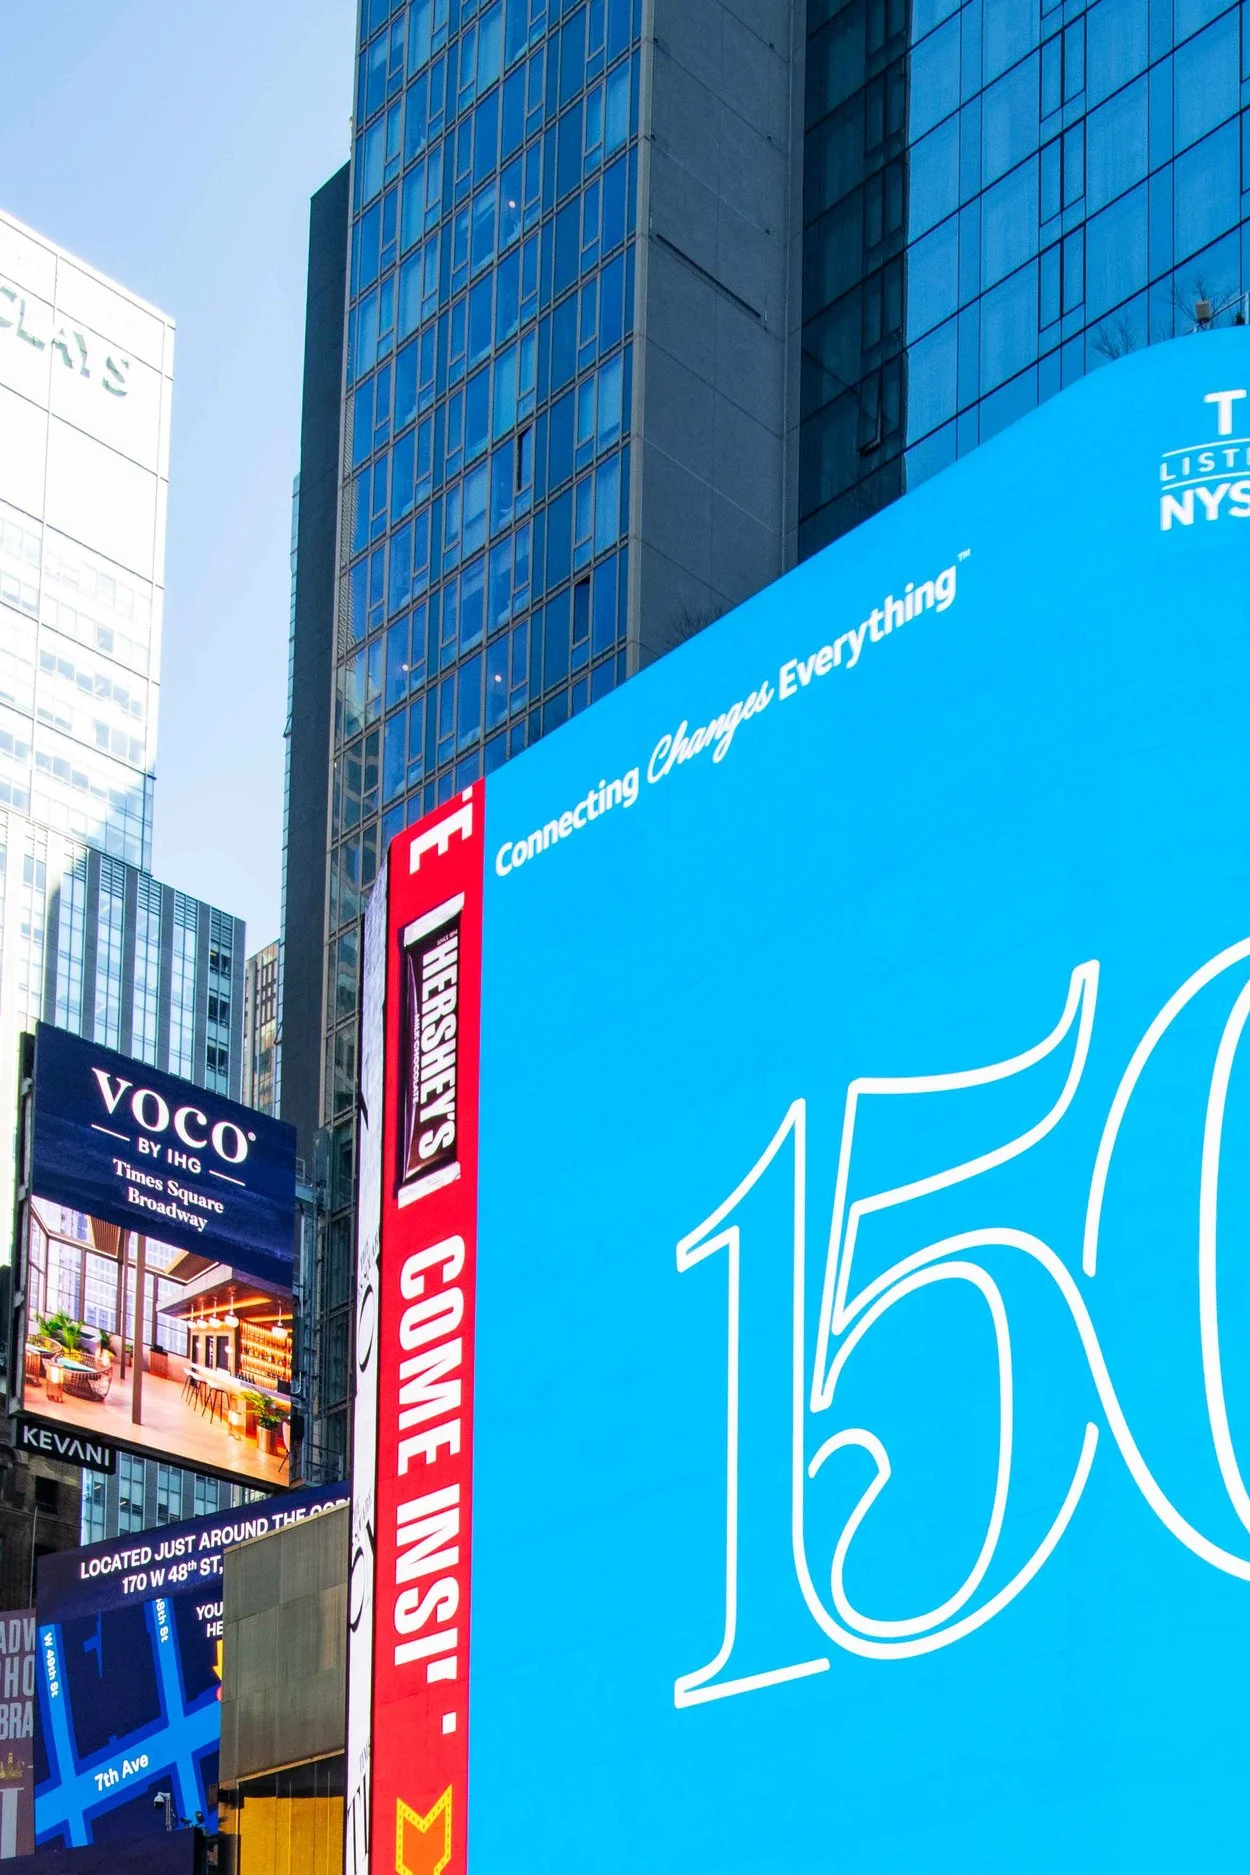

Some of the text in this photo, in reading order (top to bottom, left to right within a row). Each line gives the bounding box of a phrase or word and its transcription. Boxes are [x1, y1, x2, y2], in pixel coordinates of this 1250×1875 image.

[1203, 389, 1248, 437] T
[494, 770, 640, 878] Connecting
[647, 678, 775, 785] Changes
[418, 938, 460, 1160] HERSHEY'S
[137, 1136, 203, 1175] BY IHG
[112, 1158, 225, 1216] Times Square
[127, 1185, 209, 1235] Broadway
[22, 1424, 111, 1469] KEVANI
[394, 1234, 466, 1685] COME INSI
[80, 1546, 153, 1580] LOCATED
[153, 1535, 197, 1563] JUST
[198, 1518, 270, 1553] AROUND
[121, 1573, 147, 1596] 170
[150, 1568, 167, 1588] W
[167, 1558, 198, 1583] 48th
[159, 1627, 169, 1644] St
[195, 1601, 223, 1621] YOU
[43, 1632, 59, 1699] W 49th St
[94, 1754, 150, 1793] 7th Ave
